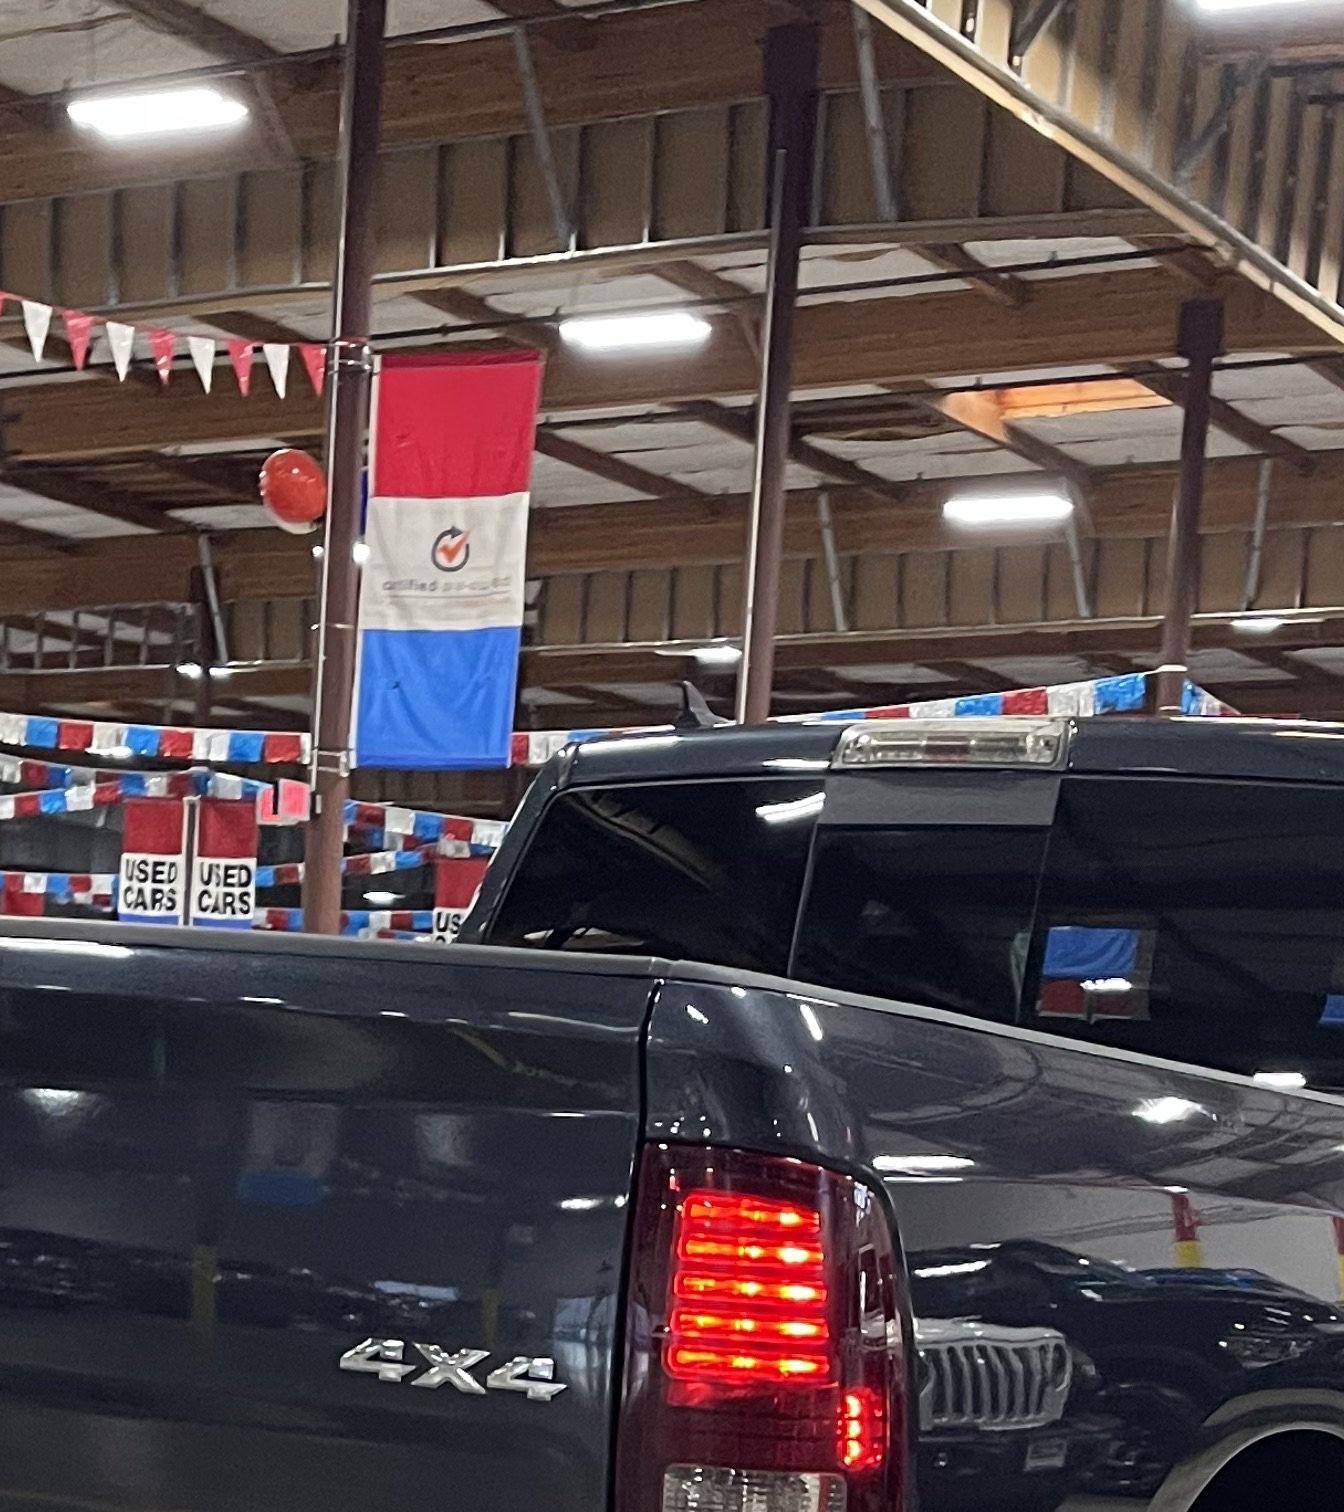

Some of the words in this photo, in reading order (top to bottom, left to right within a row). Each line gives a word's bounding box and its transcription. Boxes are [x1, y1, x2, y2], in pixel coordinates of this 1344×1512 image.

[125, 859, 178, 885] USED
[199, 862, 252, 889] USED
[123, 887, 178, 912] CARS
[198, 890, 252, 916] CARS
